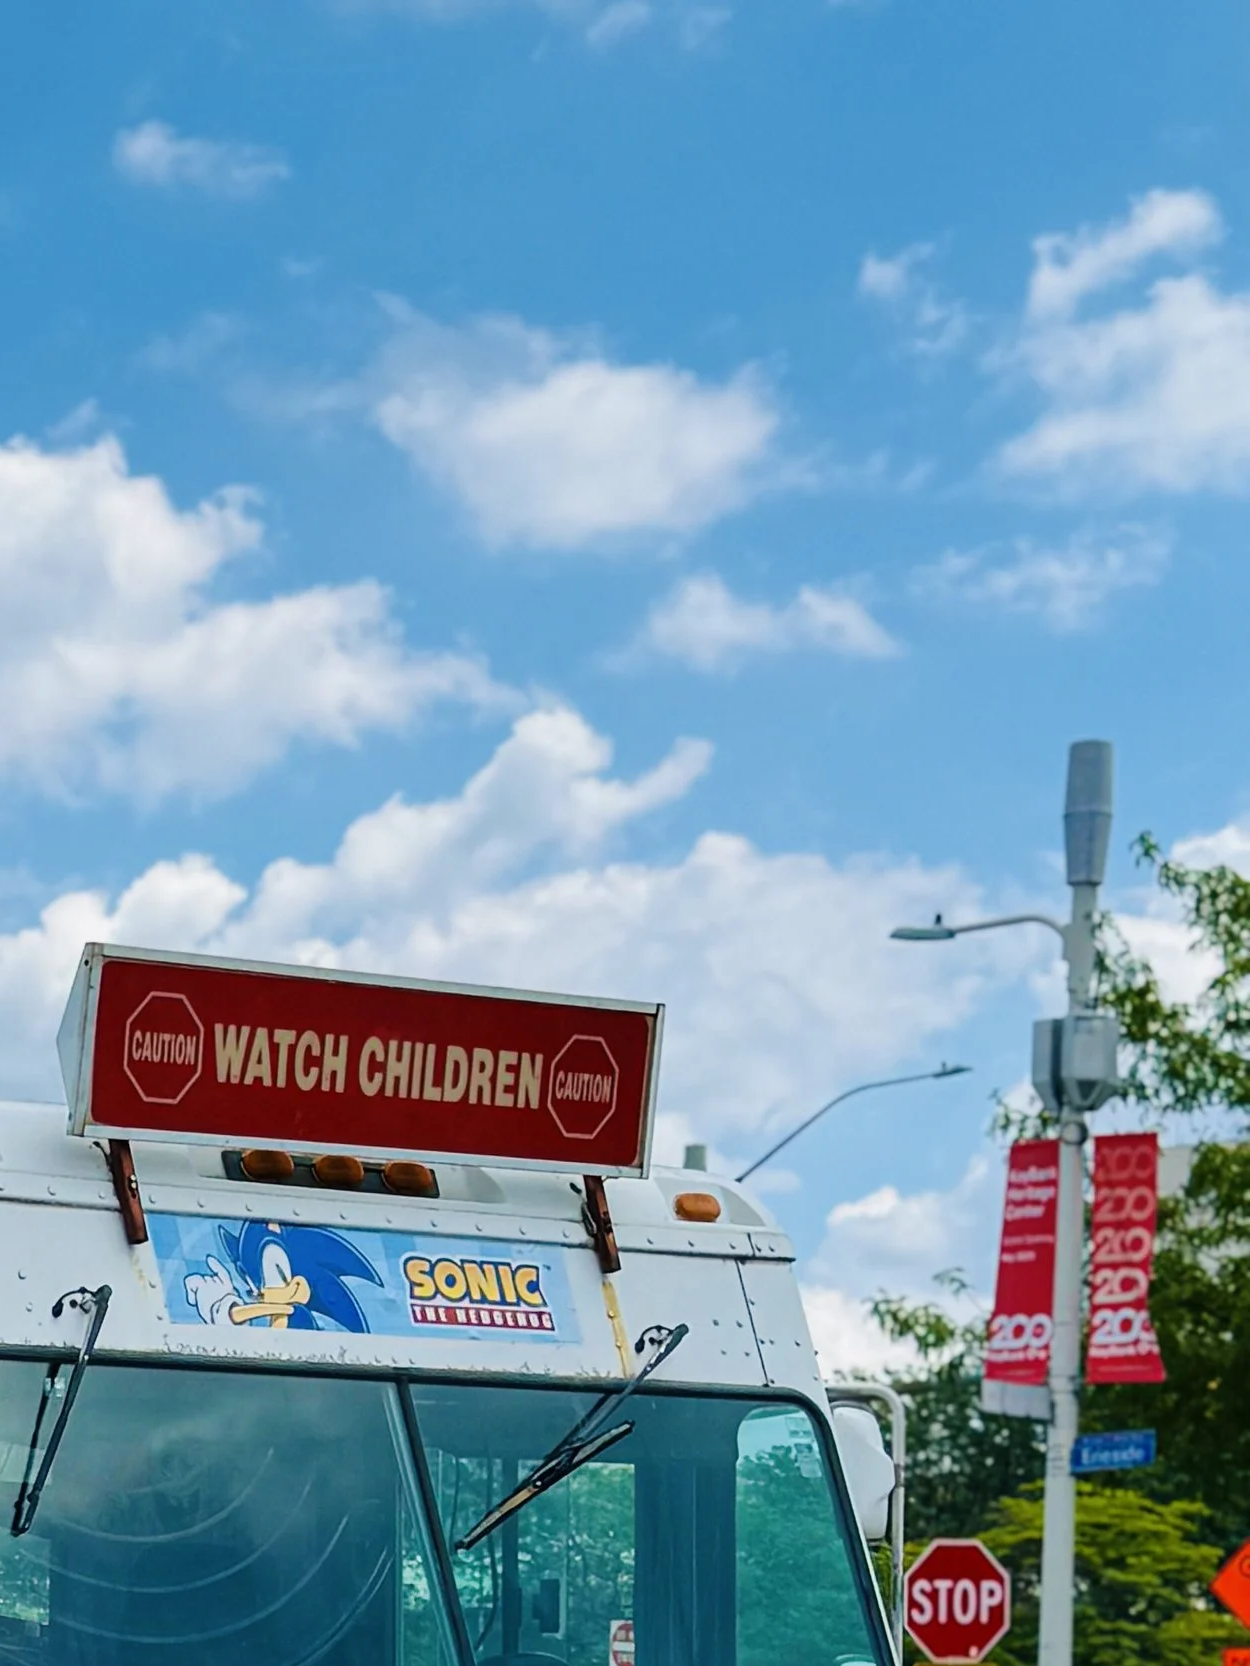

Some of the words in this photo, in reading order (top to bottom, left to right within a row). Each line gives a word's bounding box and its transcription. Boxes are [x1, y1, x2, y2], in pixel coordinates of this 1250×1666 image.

[131, 1029, 197, 1066] CAUTION
[214, 1022, 349, 1093] WATCH
[358, 1035, 544, 1110] CHILDREN
[555, 1070, 612, 1103] CAUTION
[403, 1256, 548, 1307] SONIC
[412, 1305, 448, 1323] THE
[455, 1307, 553, 1329] HEDGEHOG
[989, 1313, 1053, 1350] 200
[910, 1578, 1004, 1625] STOP
